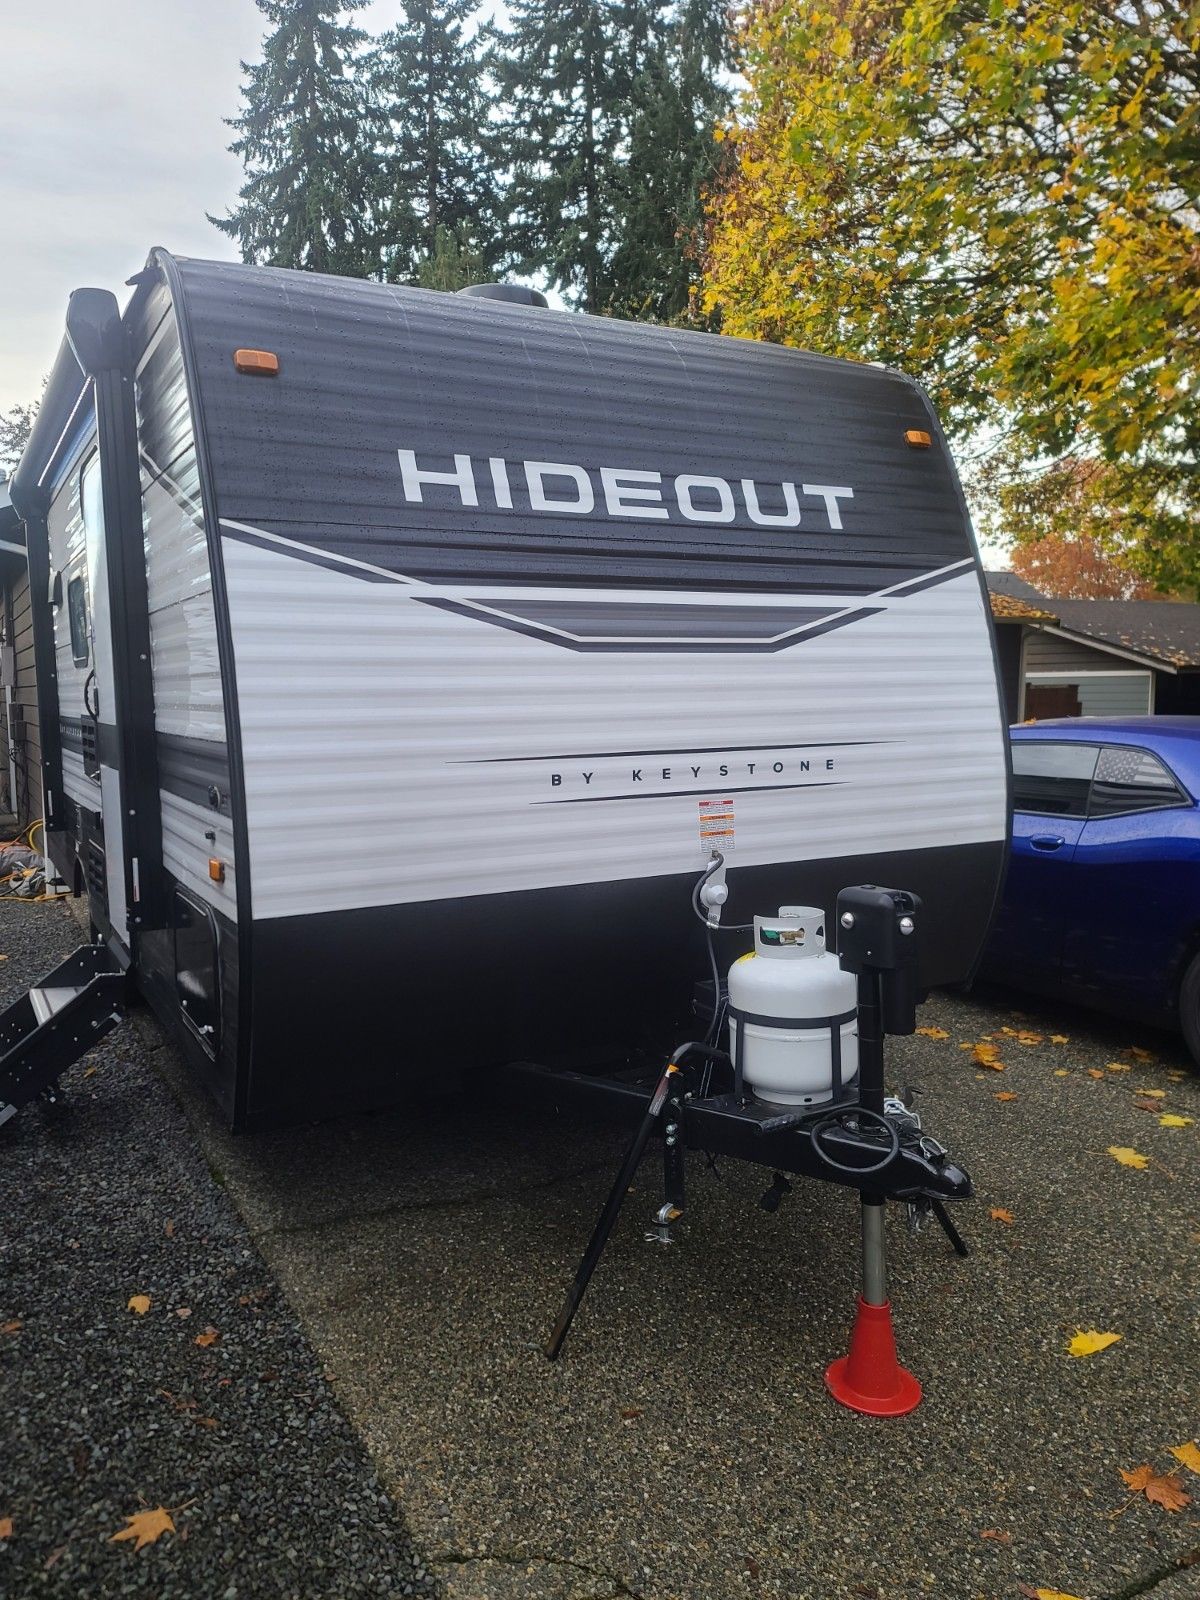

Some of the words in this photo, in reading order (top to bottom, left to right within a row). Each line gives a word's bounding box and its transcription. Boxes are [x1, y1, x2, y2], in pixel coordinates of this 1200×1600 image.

[398, 449, 854, 529] HIDEOUT
[551, 772, 594, 786] BY
[632, 759, 834, 781] KEYSTONE
